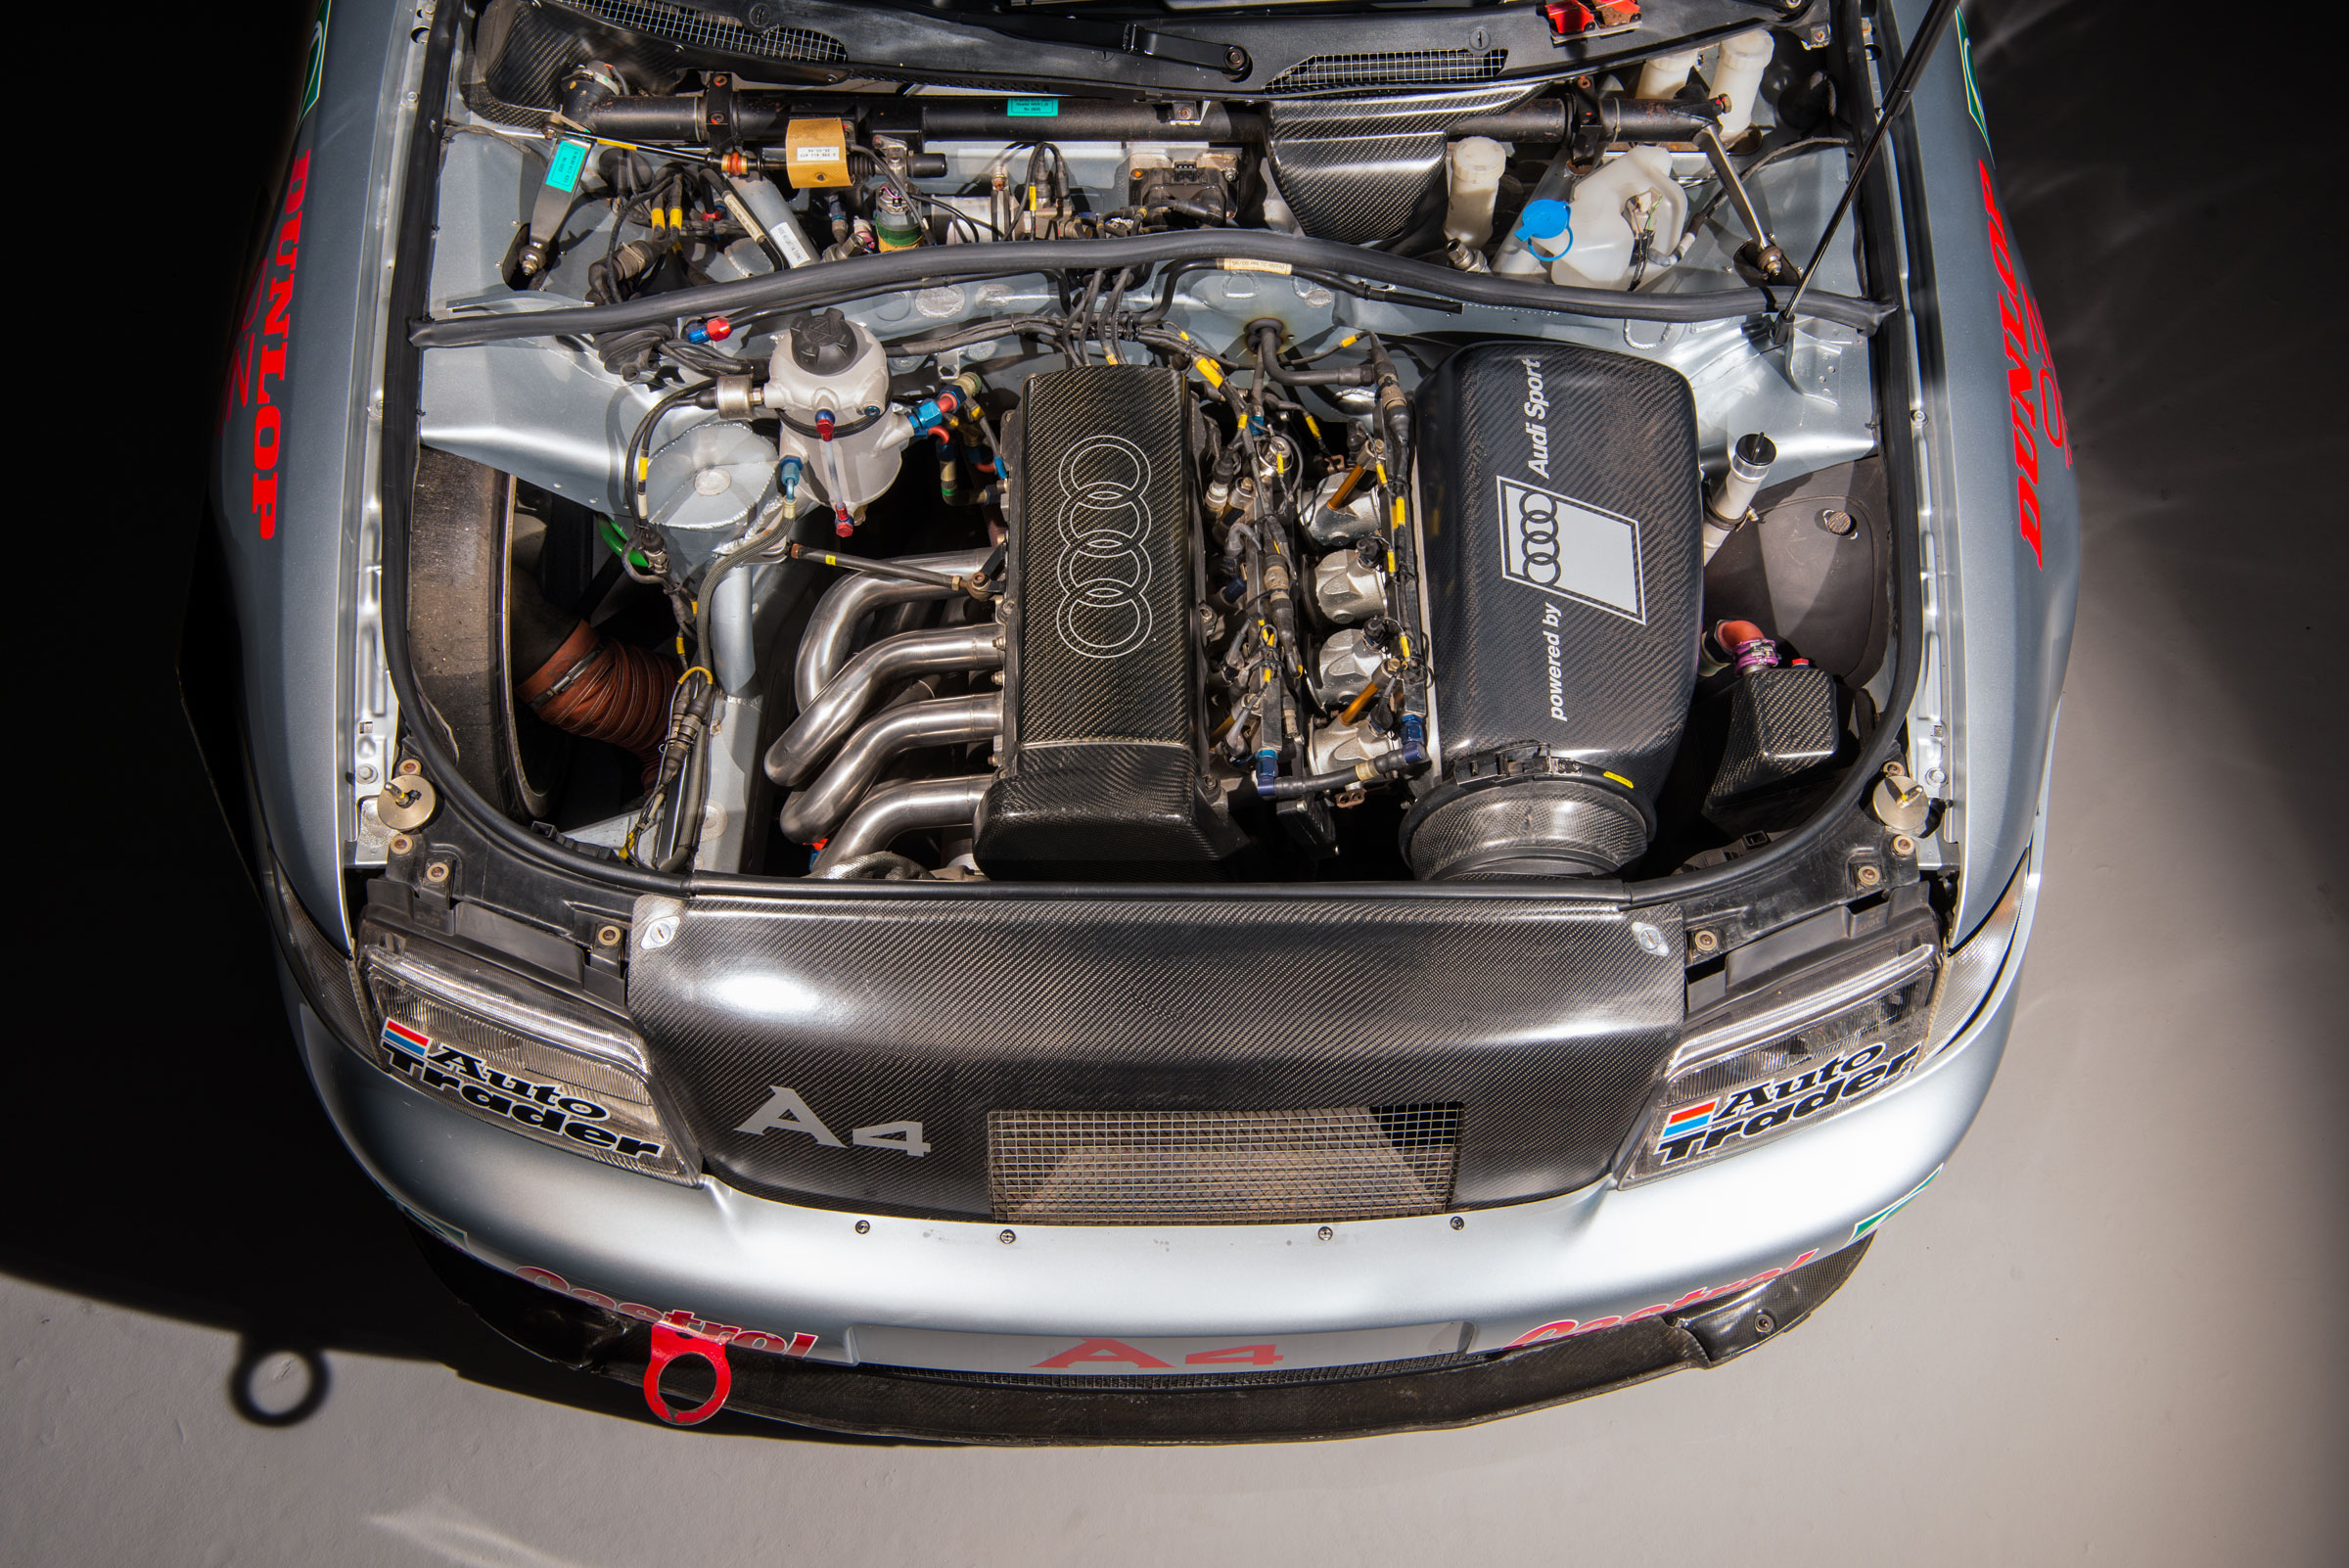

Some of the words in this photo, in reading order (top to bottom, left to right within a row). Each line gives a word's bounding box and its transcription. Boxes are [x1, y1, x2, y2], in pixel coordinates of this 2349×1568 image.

[252, 148, 311, 540] DUNLOP
[1978, 159, 2043, 571] DUNLOP
[1522, 358, 1549, 420] Sport
[1528, 422, 1549, 480] Audi
[1542, 602, 1562, 627] by
[1543, 630, 1568, 721] powered
[380, 1040, 666, 1161] Trader
[428, 1042, 612, 1123] Auto
[735, 1084, 931, 1157] A4
[1654, 1041, 1921, 1166] Trader
[1716, 1041, 1886, 1120] Auto
[1029, 1337, 1283, 1369] A4
